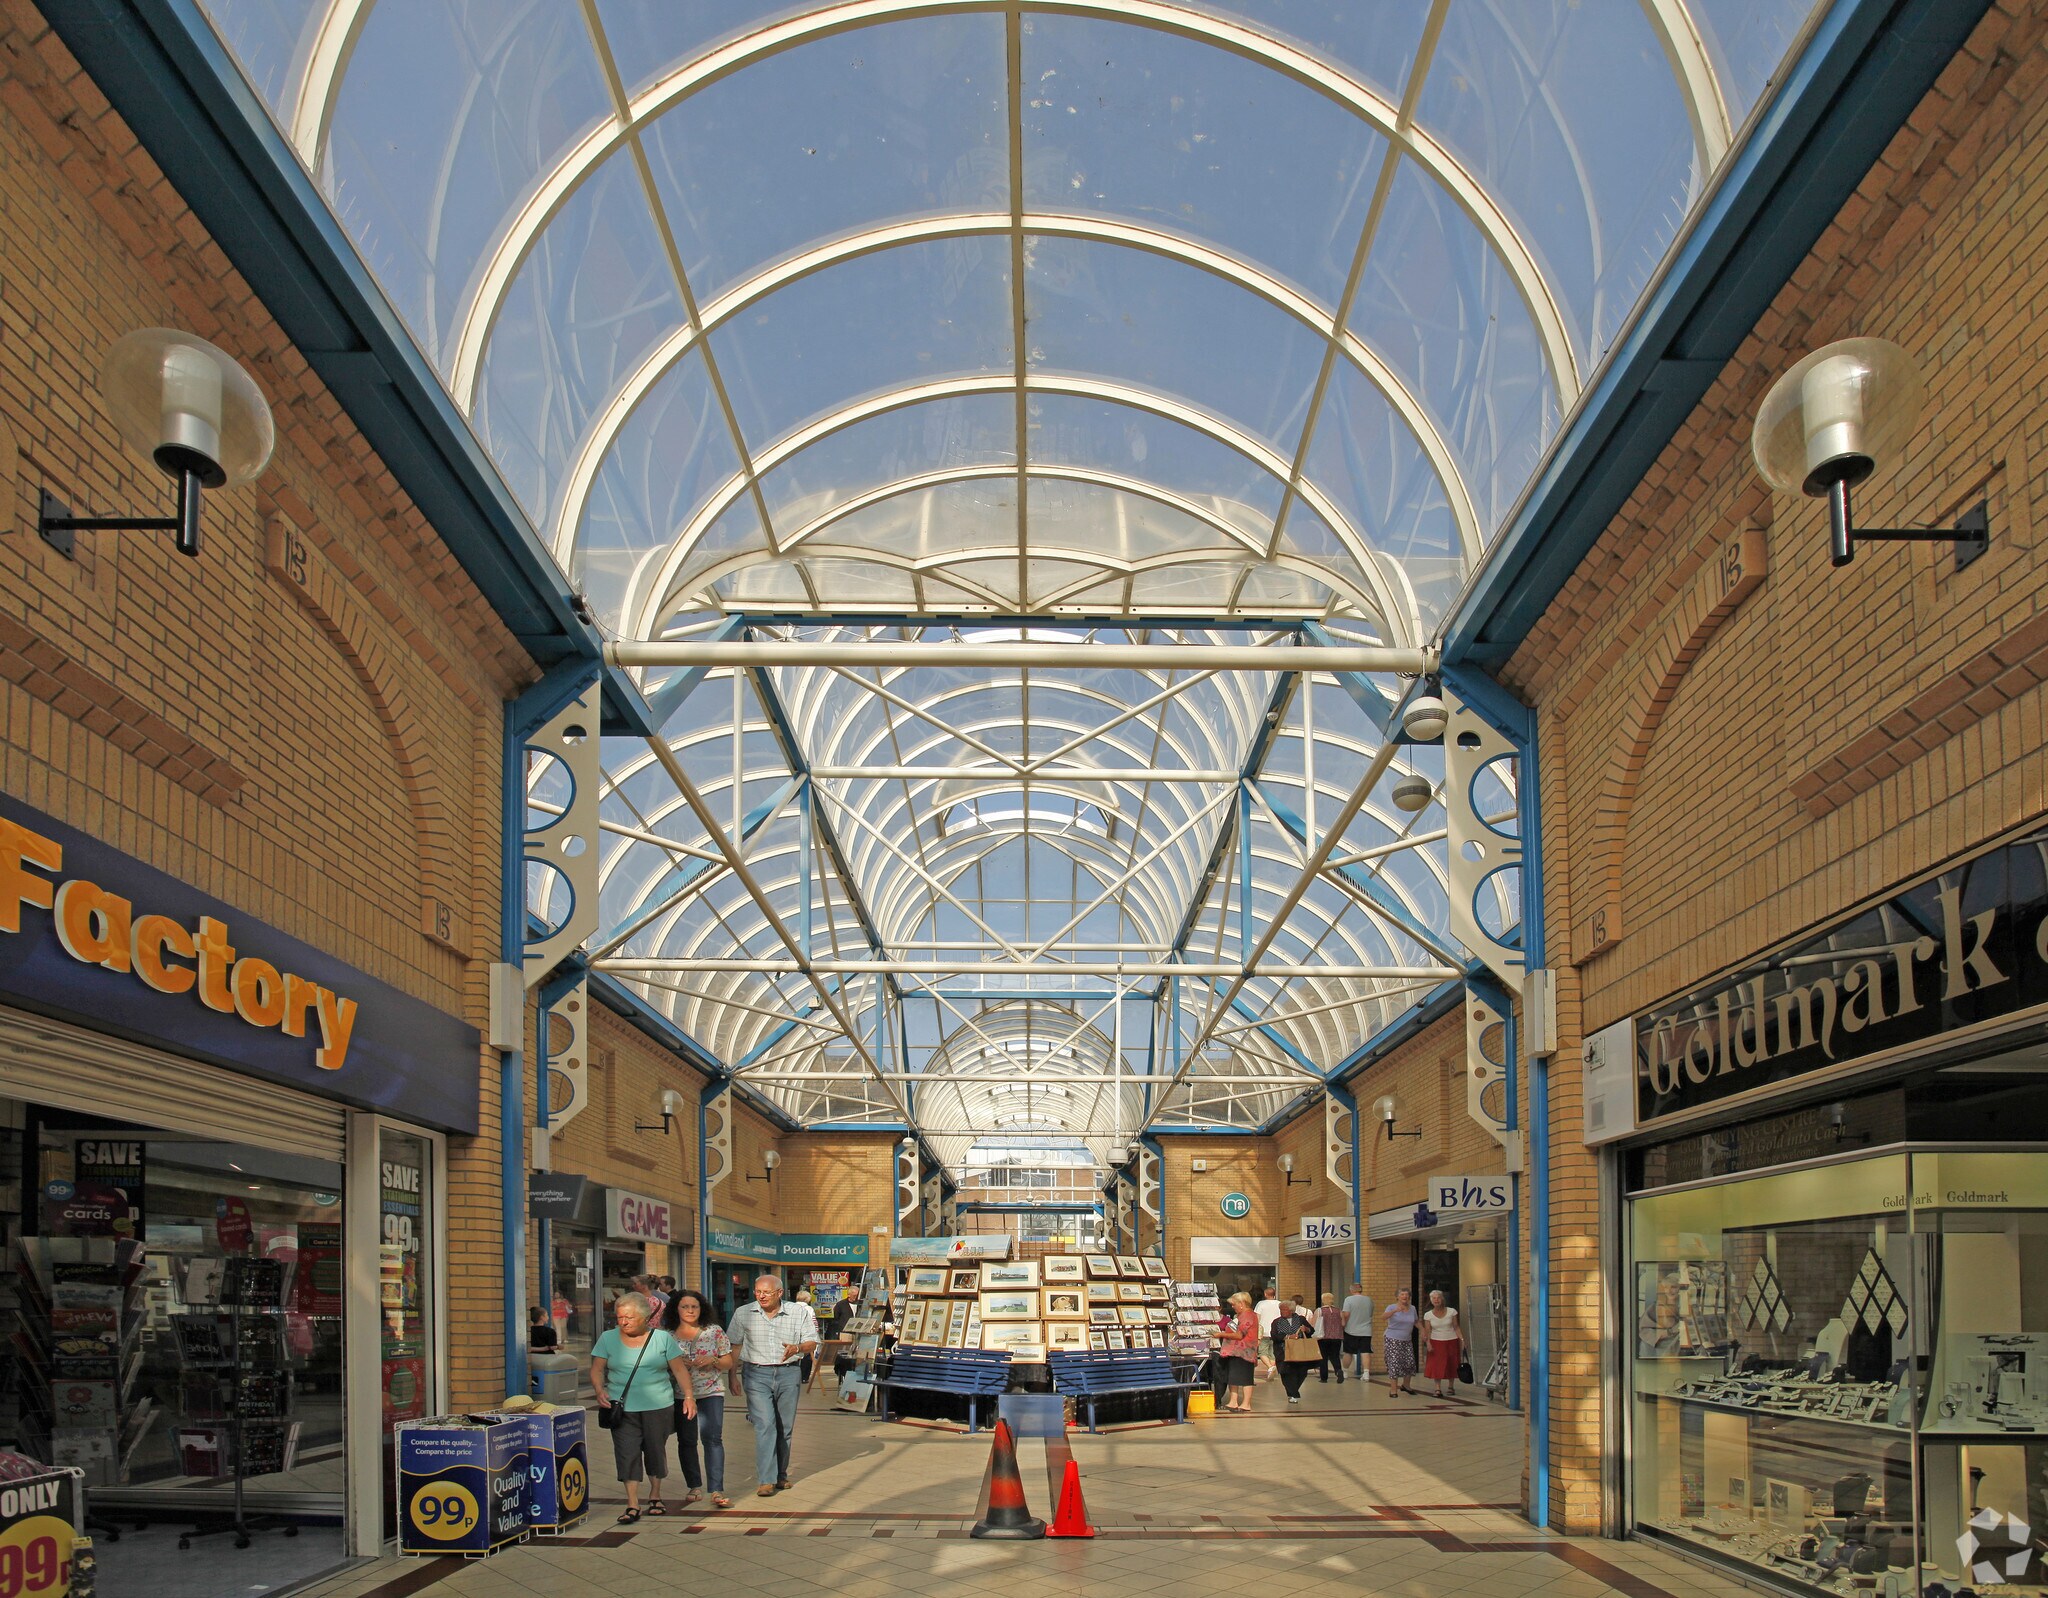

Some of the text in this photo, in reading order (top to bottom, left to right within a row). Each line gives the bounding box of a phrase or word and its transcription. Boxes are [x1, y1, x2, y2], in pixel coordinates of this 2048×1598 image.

[0, 817, 359, 1071] Factory
[1647, 886, 2010, 1096] Goldmark
[1756, 1136, 1785, 1154] Gold
[1788, 1130, 1811, 1147] into
[1815, 1123, 1847, 1142] Cash
[80, 1142, 141, 1165] SAVE
[382, 1161, 419, 1193] SAVE
[529, 1190, 564, 1198] everything
[534, 1196, 571, 1204] everywhere
[1882, 1192, 1933, 1208] Goldark
[1947, 1190, 2009, 1203] Goldmark
[63, 1209, 112, 1221] cards
[383, 1201, 419, 1217] ESSENTIALS
[621, 1197, 669, 1240] GAME
[384, 1213, 419, 1254] 99p
[714, 1228, 745, 1249] Poundland
[783, 1244, 847, 1256] Poundland
[811, 1273, 838, 1281] VALUE
[410, 1438, 439, 1447] Compare
[440, 1438, 450, 1446] the
[415, 1448, 444, 1456] Compare
[456, 1448, 473, 1456] price
[493, 1471, 528, 1496] Quality
[563, 1469, 585, 1501] 99p
[0, 1480, 60, 1518] ONLY
[501, 1491, 520, 1512] and
[418, 1495, 474, 1528] 99p
[497, 1511, 524, 1534] Value
